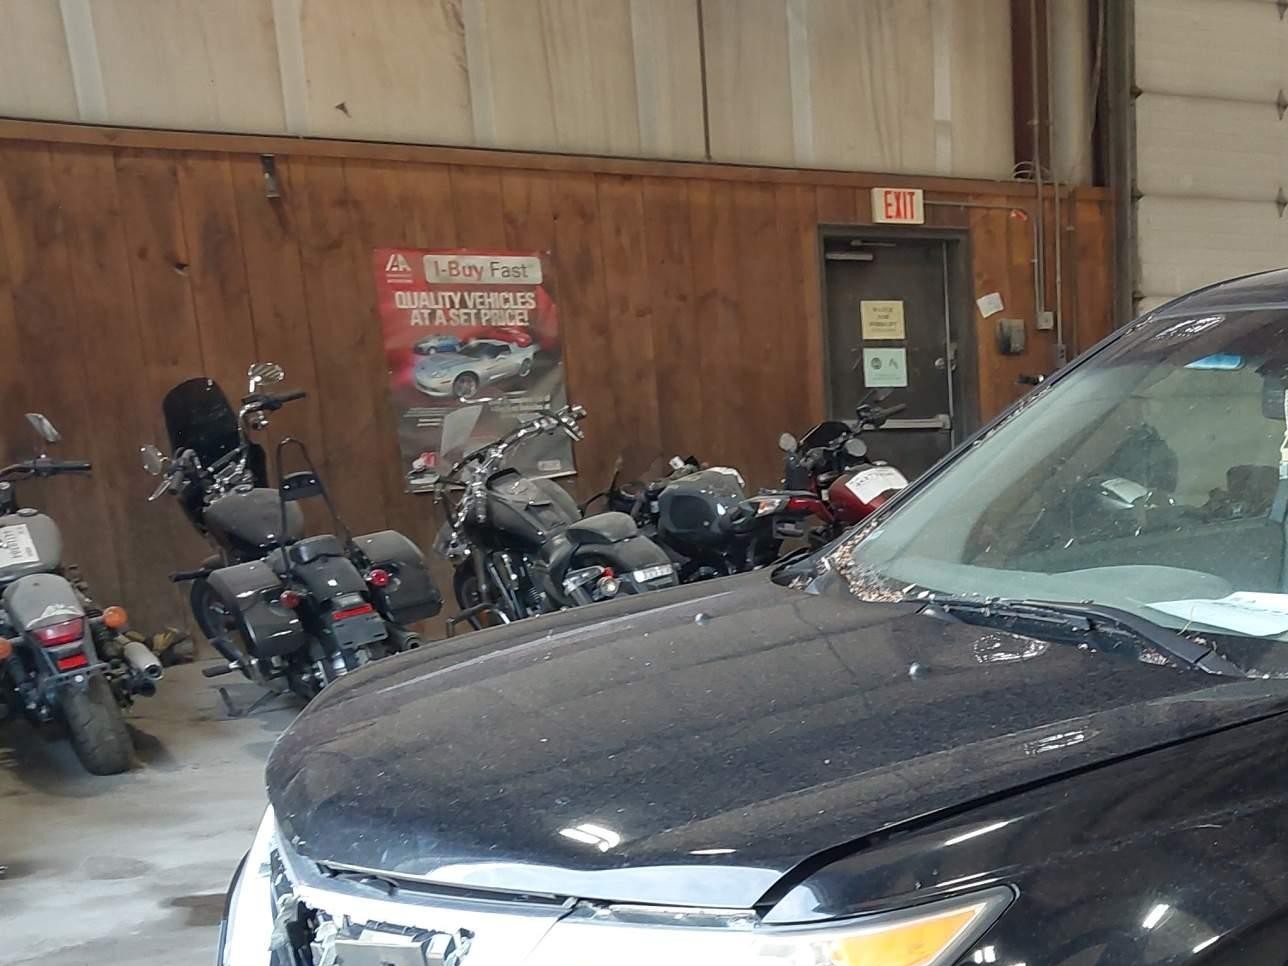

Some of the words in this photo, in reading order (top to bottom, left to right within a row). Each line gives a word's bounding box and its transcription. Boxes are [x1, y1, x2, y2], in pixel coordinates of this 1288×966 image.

[884, 190, 915, 219] EXIT
[490, 261, 529, 279] Fast
[394, 291, 461, 309] QUALITY
[463, 291, 536, 309] VEHICLES
[410, 308, 432, 326] AT
[434, 308, 447, 326] A
[449, 309, 478, 326] SET
[481, 309, 530, 327] PRICE!
